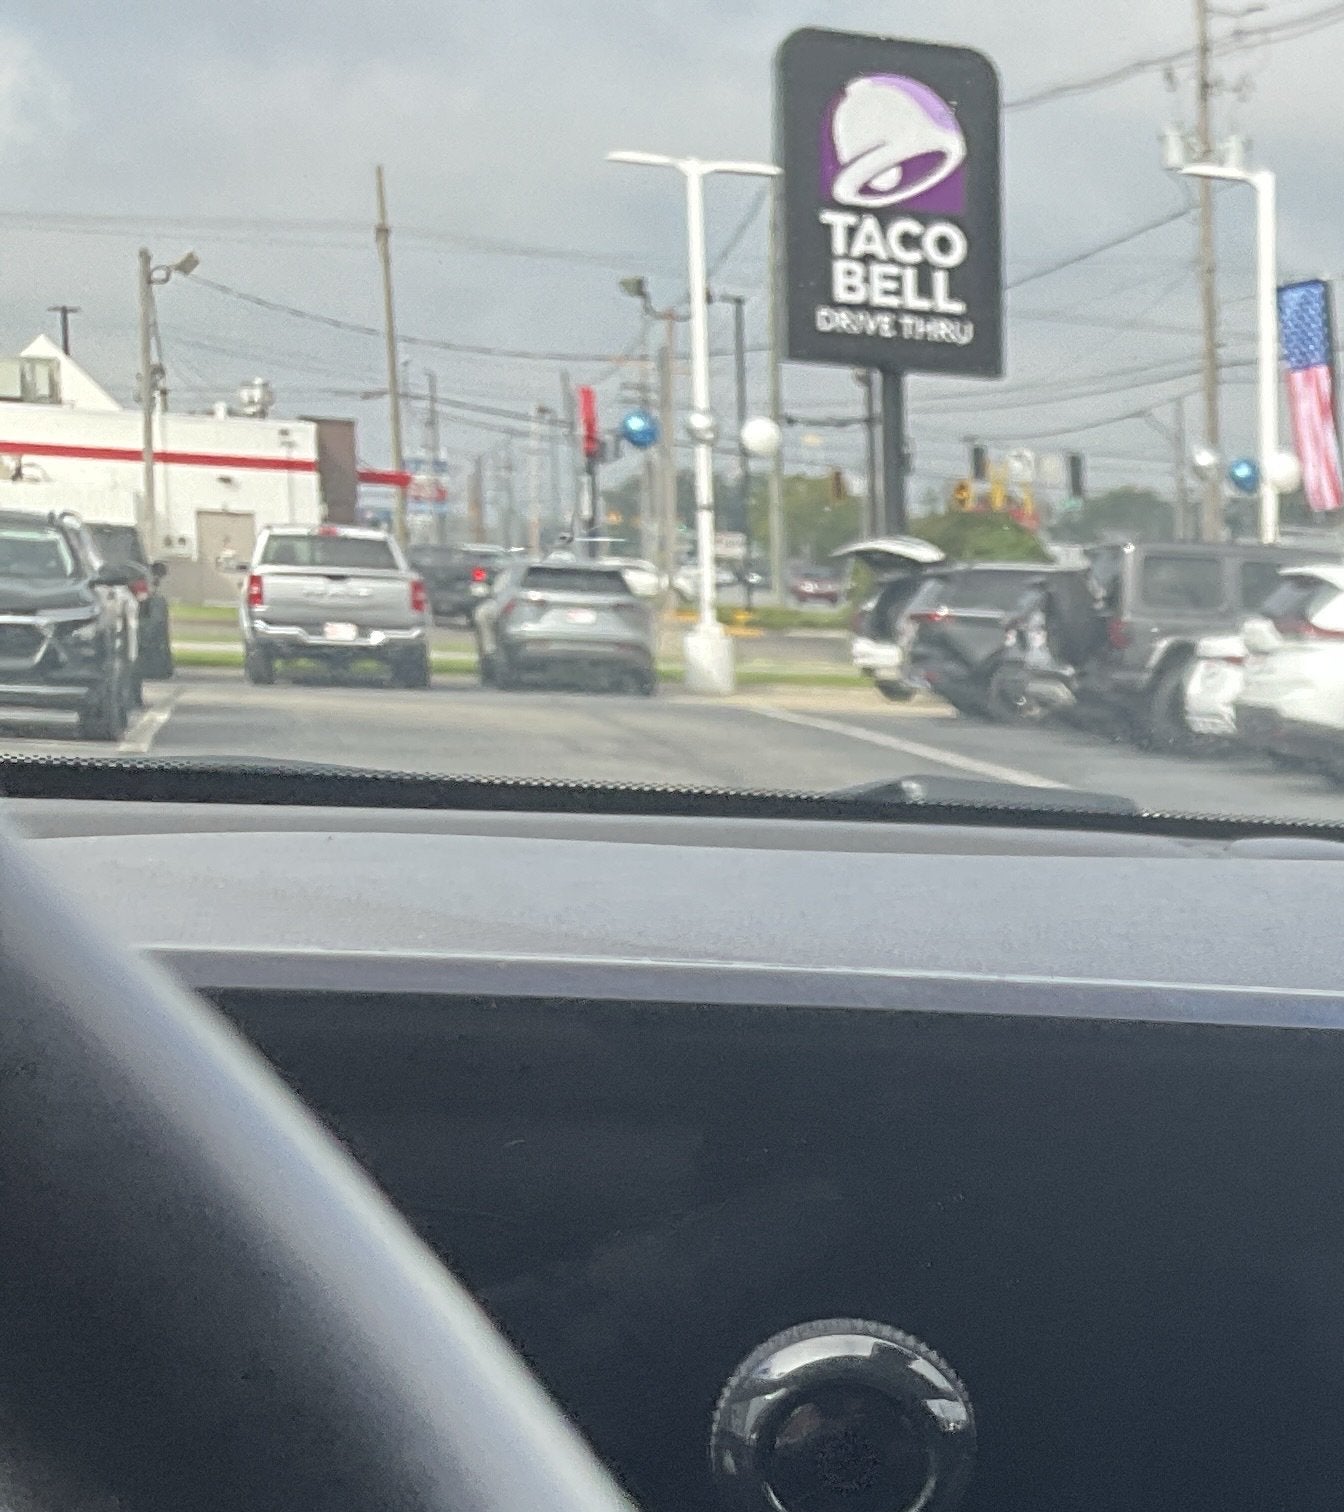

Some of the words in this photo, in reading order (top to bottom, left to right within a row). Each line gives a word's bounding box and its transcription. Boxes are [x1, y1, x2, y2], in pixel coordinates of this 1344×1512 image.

[818, 209, 968, 269] TACO
[831, 258, 967, 315] BELL
[815, 306, 897, 338] DRIVE
[900, 316, 975, 346] THRU
